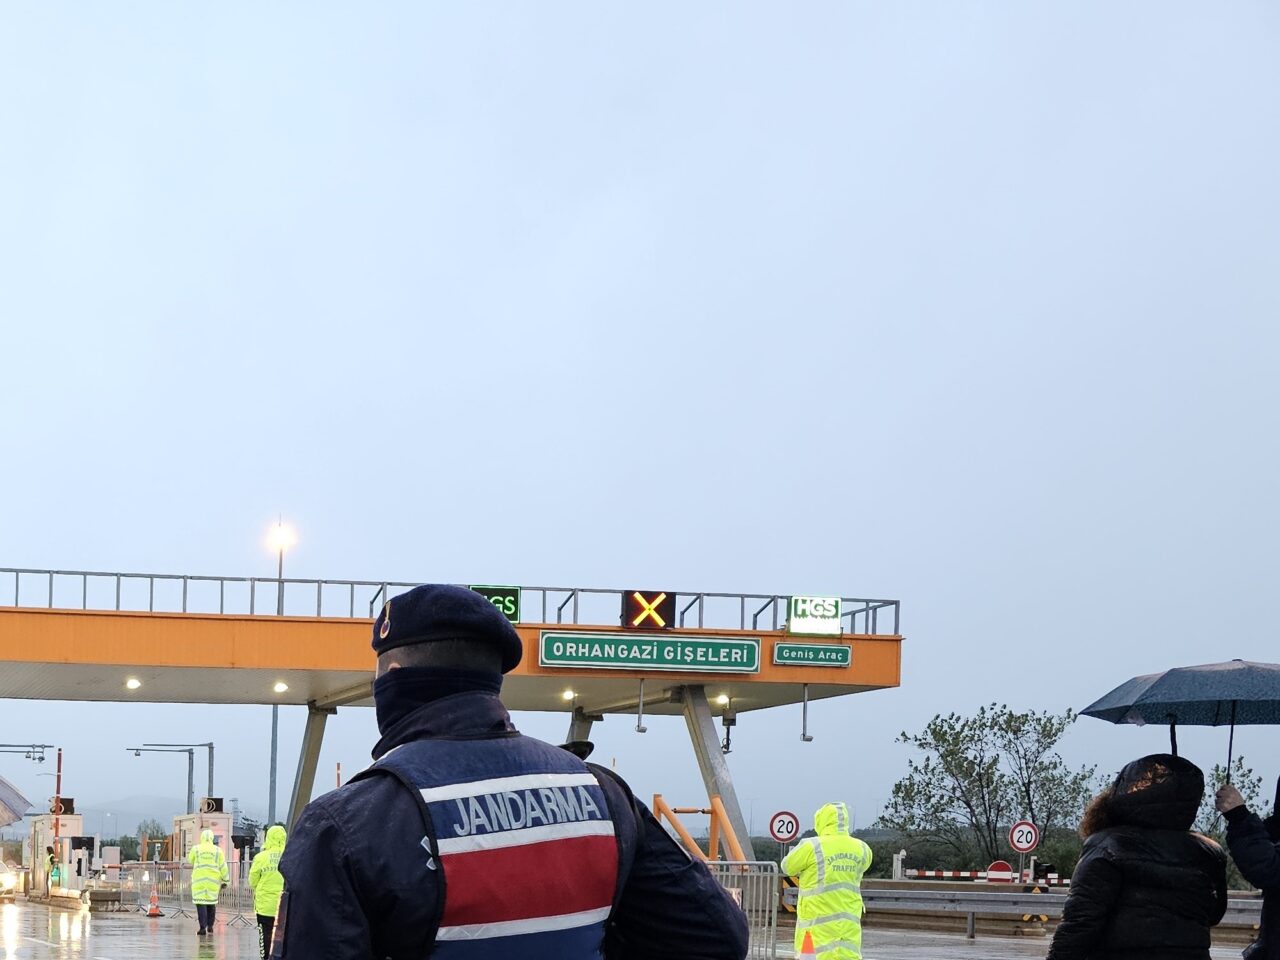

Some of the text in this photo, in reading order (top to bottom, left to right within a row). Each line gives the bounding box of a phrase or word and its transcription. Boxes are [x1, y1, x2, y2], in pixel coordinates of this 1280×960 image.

[484, 596, 516, 614] GS
[797, 599, 837, 617] HGS
[553, 641, 748, 663] ORHANGAZİ GİŞELERİ
[783, 649, 843, 661] Geniş Araç
[453, 785, 602, 836] JANDARMA
[777, 820, 794, 834] 20
[1017, 830, 1033, 844] 20
